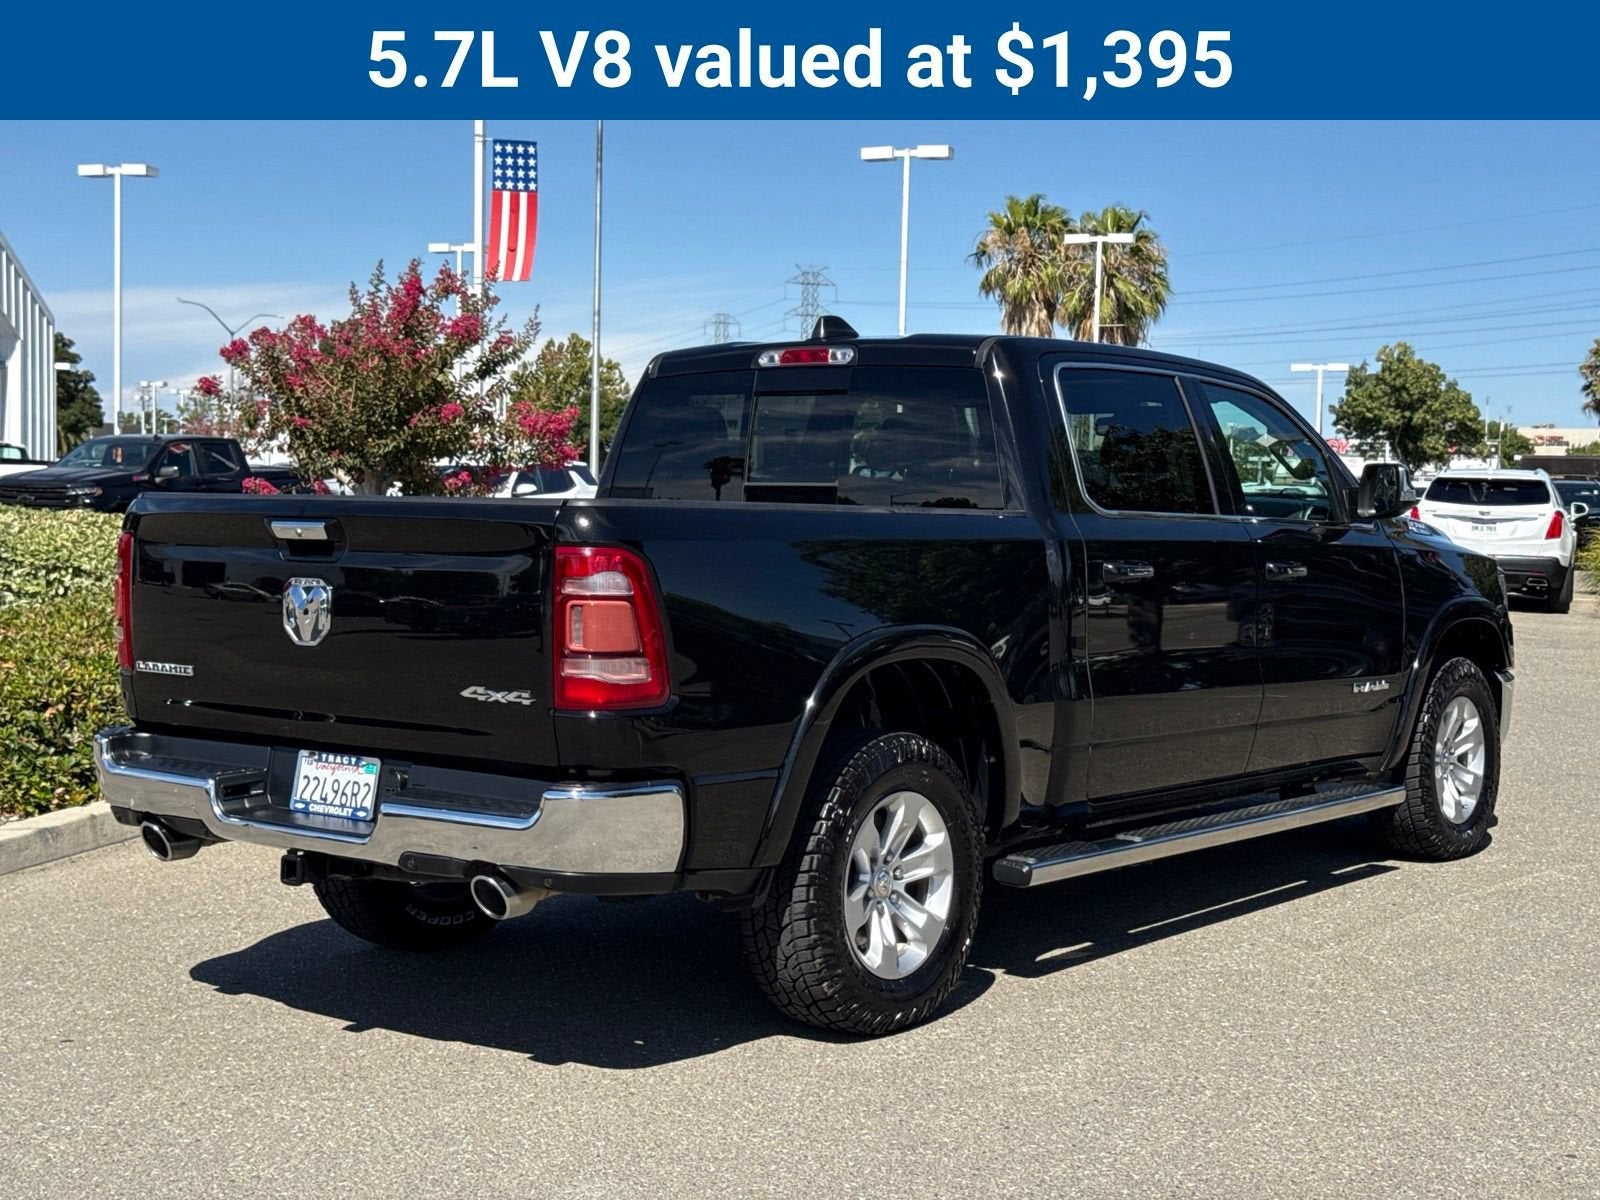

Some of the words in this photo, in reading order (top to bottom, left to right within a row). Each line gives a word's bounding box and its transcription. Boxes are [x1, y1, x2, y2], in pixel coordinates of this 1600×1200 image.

[135, 660, 194, 676] LARAMIE
[321, 753, 357, 765] TRACY
[300, 774, 371, 809] 22496R2
[308, 802, 354, 817] CHEVROLET
[405, 903, 475, 926] COOPER
